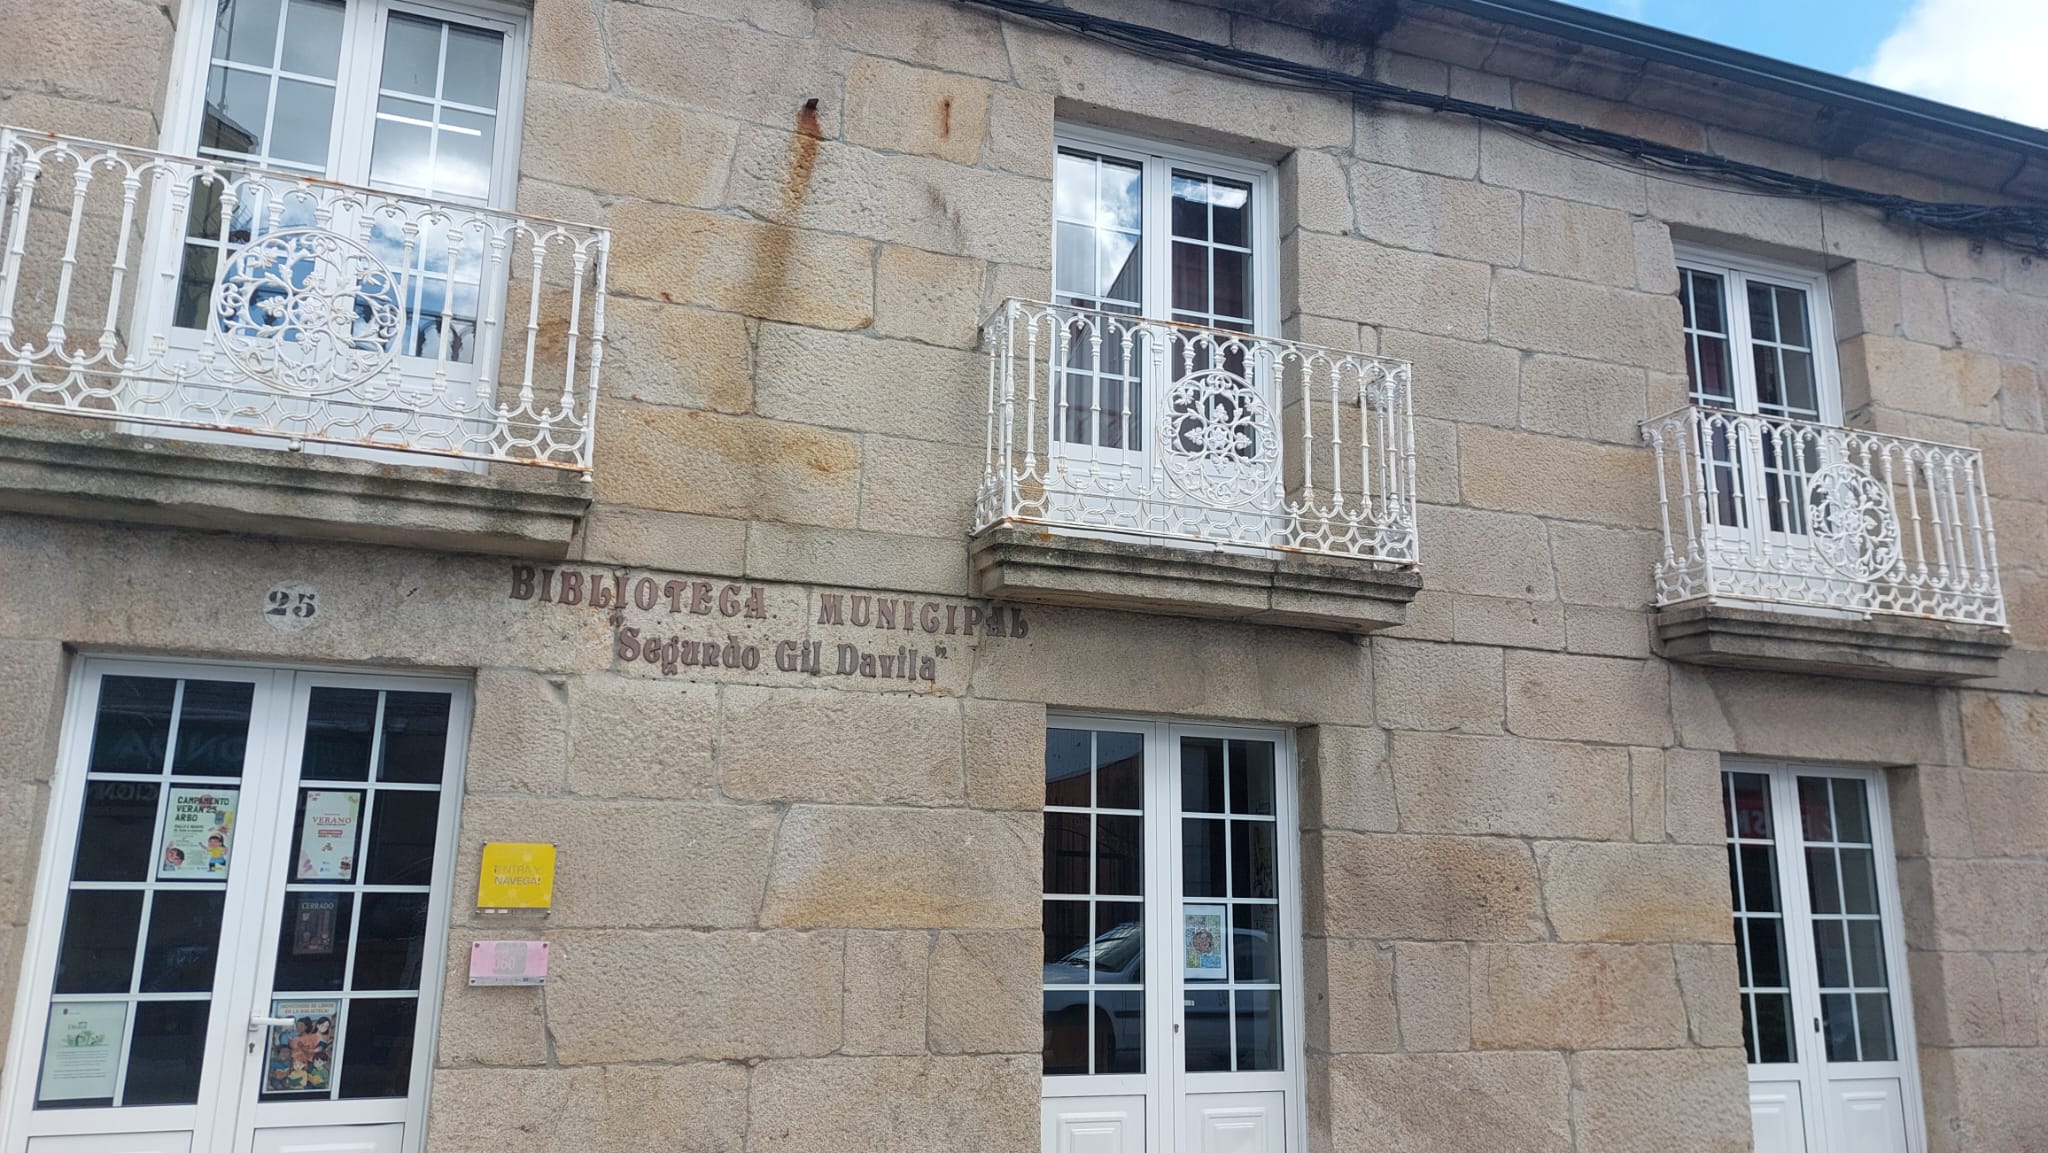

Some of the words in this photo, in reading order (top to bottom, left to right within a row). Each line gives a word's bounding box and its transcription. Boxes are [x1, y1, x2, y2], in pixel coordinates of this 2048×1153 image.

[266, 591, 315, 618] 25
[509, 566, 767, 619] BIBLIOTECA
[817, 593, 1029, 638] MUNICIPAL
[775, 639, 822, 675] Gil
[177, 796, 230, 806] CAMPAMENTO
[174, 813, 198, 822] ARBO
[312, 816, 352, 824] VERANO
[301, 902, 335, 910] CERRADO
